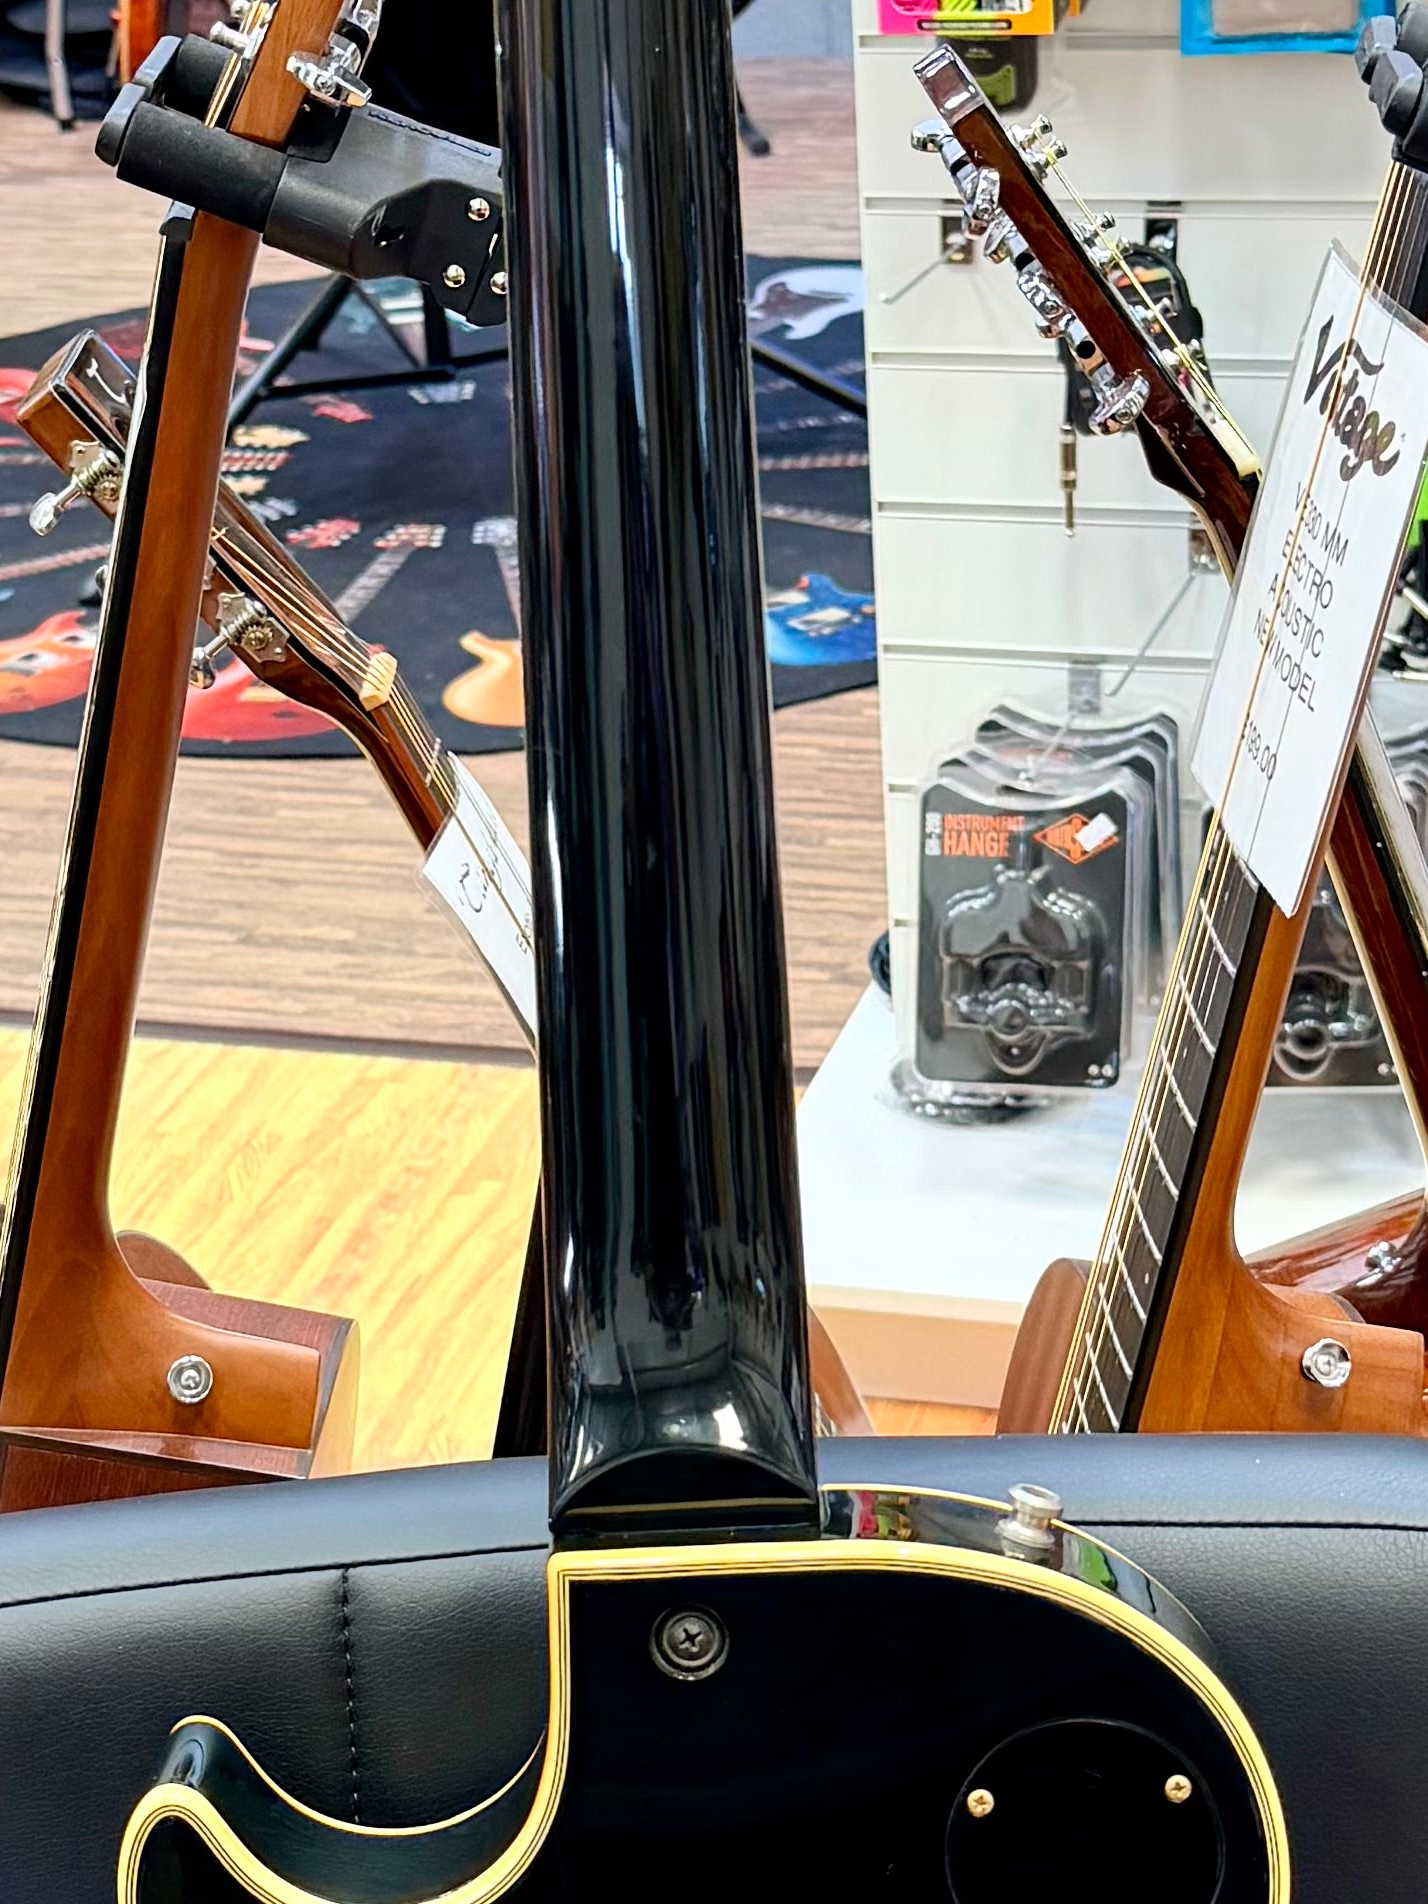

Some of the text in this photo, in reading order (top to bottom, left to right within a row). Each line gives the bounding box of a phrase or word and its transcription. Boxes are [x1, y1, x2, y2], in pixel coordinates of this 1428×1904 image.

[1302, 316, 1400, 482] Vintage
[1281, 528, 1334, 610] EECTRO
[1323, 520, 1349, 567] MM
[1268, 572, 1325, 659] AOUSTIC
[1273, 646, 1316, 713] MODEL
[943, 812, 1026, 831] INSTRUMENT
